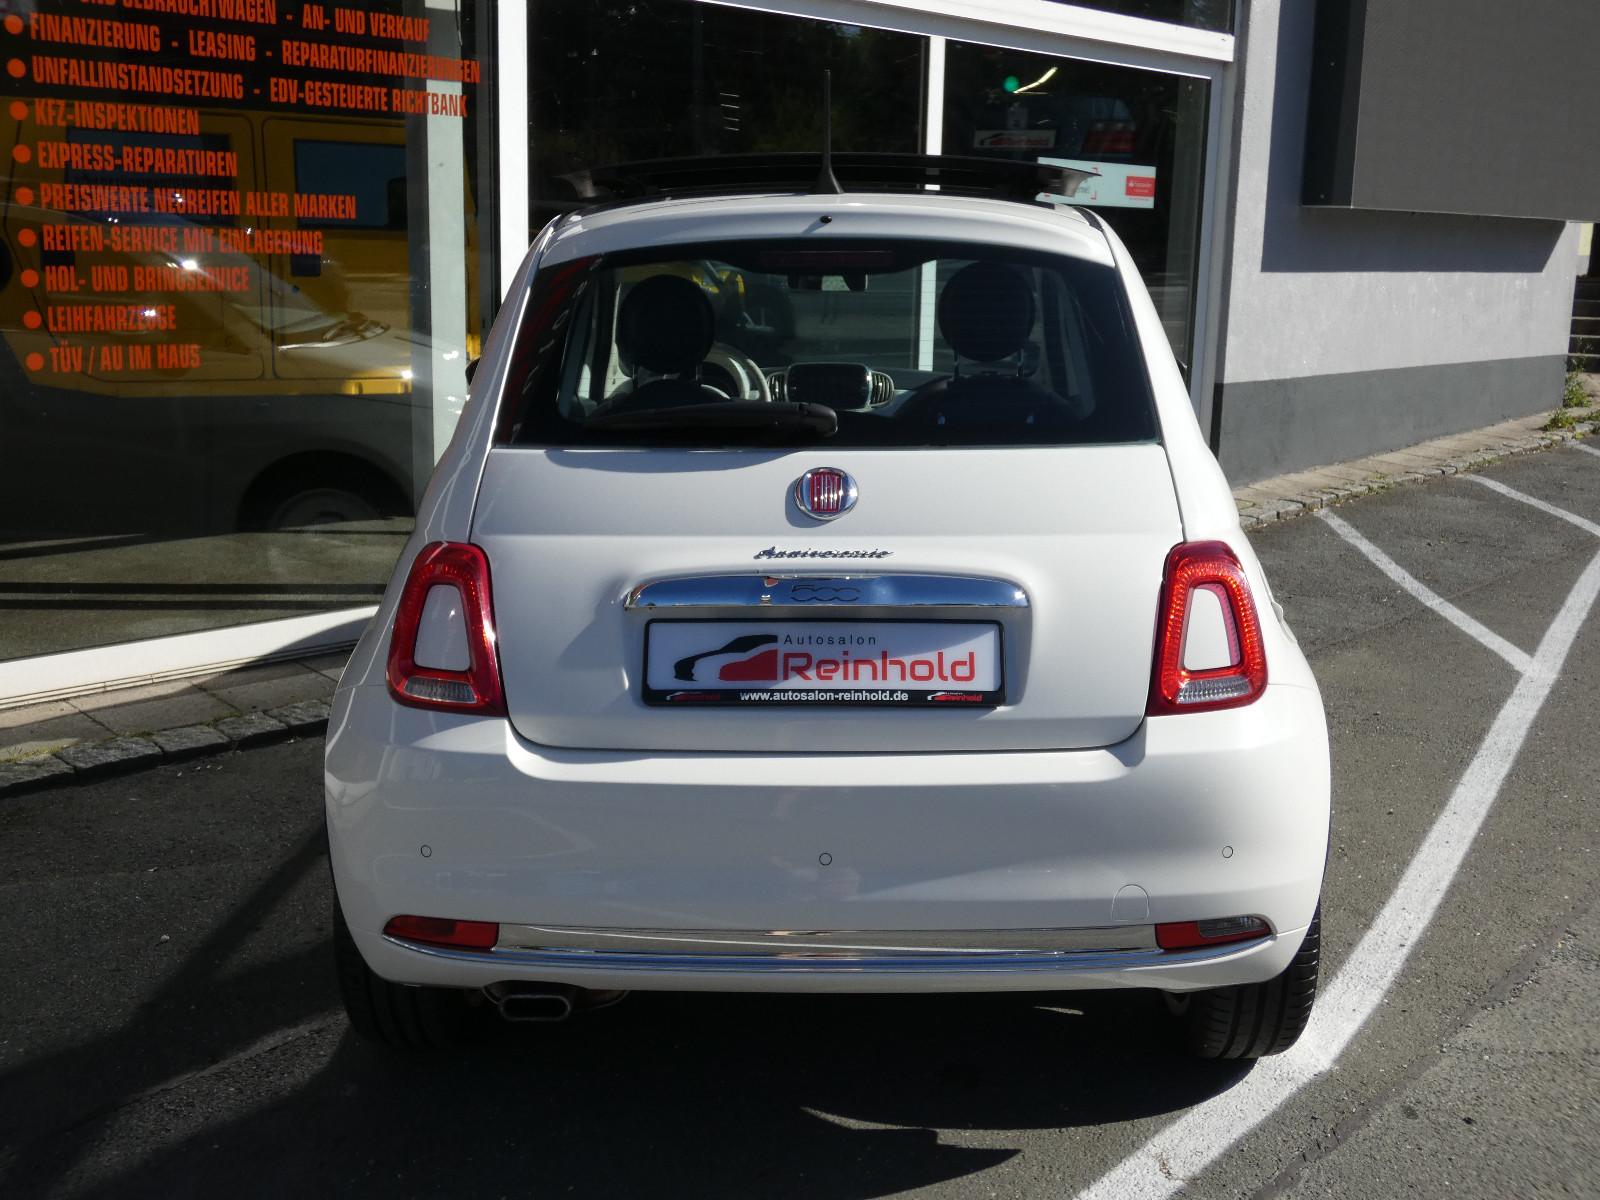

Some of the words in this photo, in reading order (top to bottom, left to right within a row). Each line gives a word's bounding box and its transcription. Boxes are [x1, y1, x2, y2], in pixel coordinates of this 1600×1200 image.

[302, 4, 330, 31] AN-
[335, 8, 366, 35] UND
[370, 12, 430, 42] VERKAUF
[30, 12, 161, 52] FINANZIERUNG
[189, 29, 255, 61] LEASING
[282, 40, 481, 83] REPARATURFINANZIEEN
[32, 55, 244, 99] UNFALLINSTANDSETZUNG
[270, 77, 388, 112] EDV-GESTEUERTE
[392, 88, 467, 118] RICHTBANK
[35, 98, 200, 135] KFZ-INSPEKTIONEN
[37, 141, 238, 177] EXPRESS-REPARATUREN
[40, 183, 149, 213] PREISWERTE
[154, 187, 240, 216] NEUREIFEN
[246, 192, 289, 217] ALLER
[293, 194, 357, 219] MARKEN
[42, 225, 178, 253] REIFEN-SERVICE
[183, 228, 213, 253] MIT
[219, 229, 324, 255] EINLAGERUNG
[45, 266, 86, 292] HOL-
[92, 266, 128, 292] UND
[134, 265, 249, 292] BRINGSERVICE
[47, 305, 176, 332] LEIHFAHRZEUGE
[50, 340, 82, 373] TÜV
[101, 345, 124, 371] AU
[129, 345, 152, 370] IM
[157, 344, 202, 370] HAUS
[783, 634, 876, 646] Autosalon
[782, 650, 976, 682] Reinhold
[740, 689, 909, 702] www.autosalon-reinhold.de
